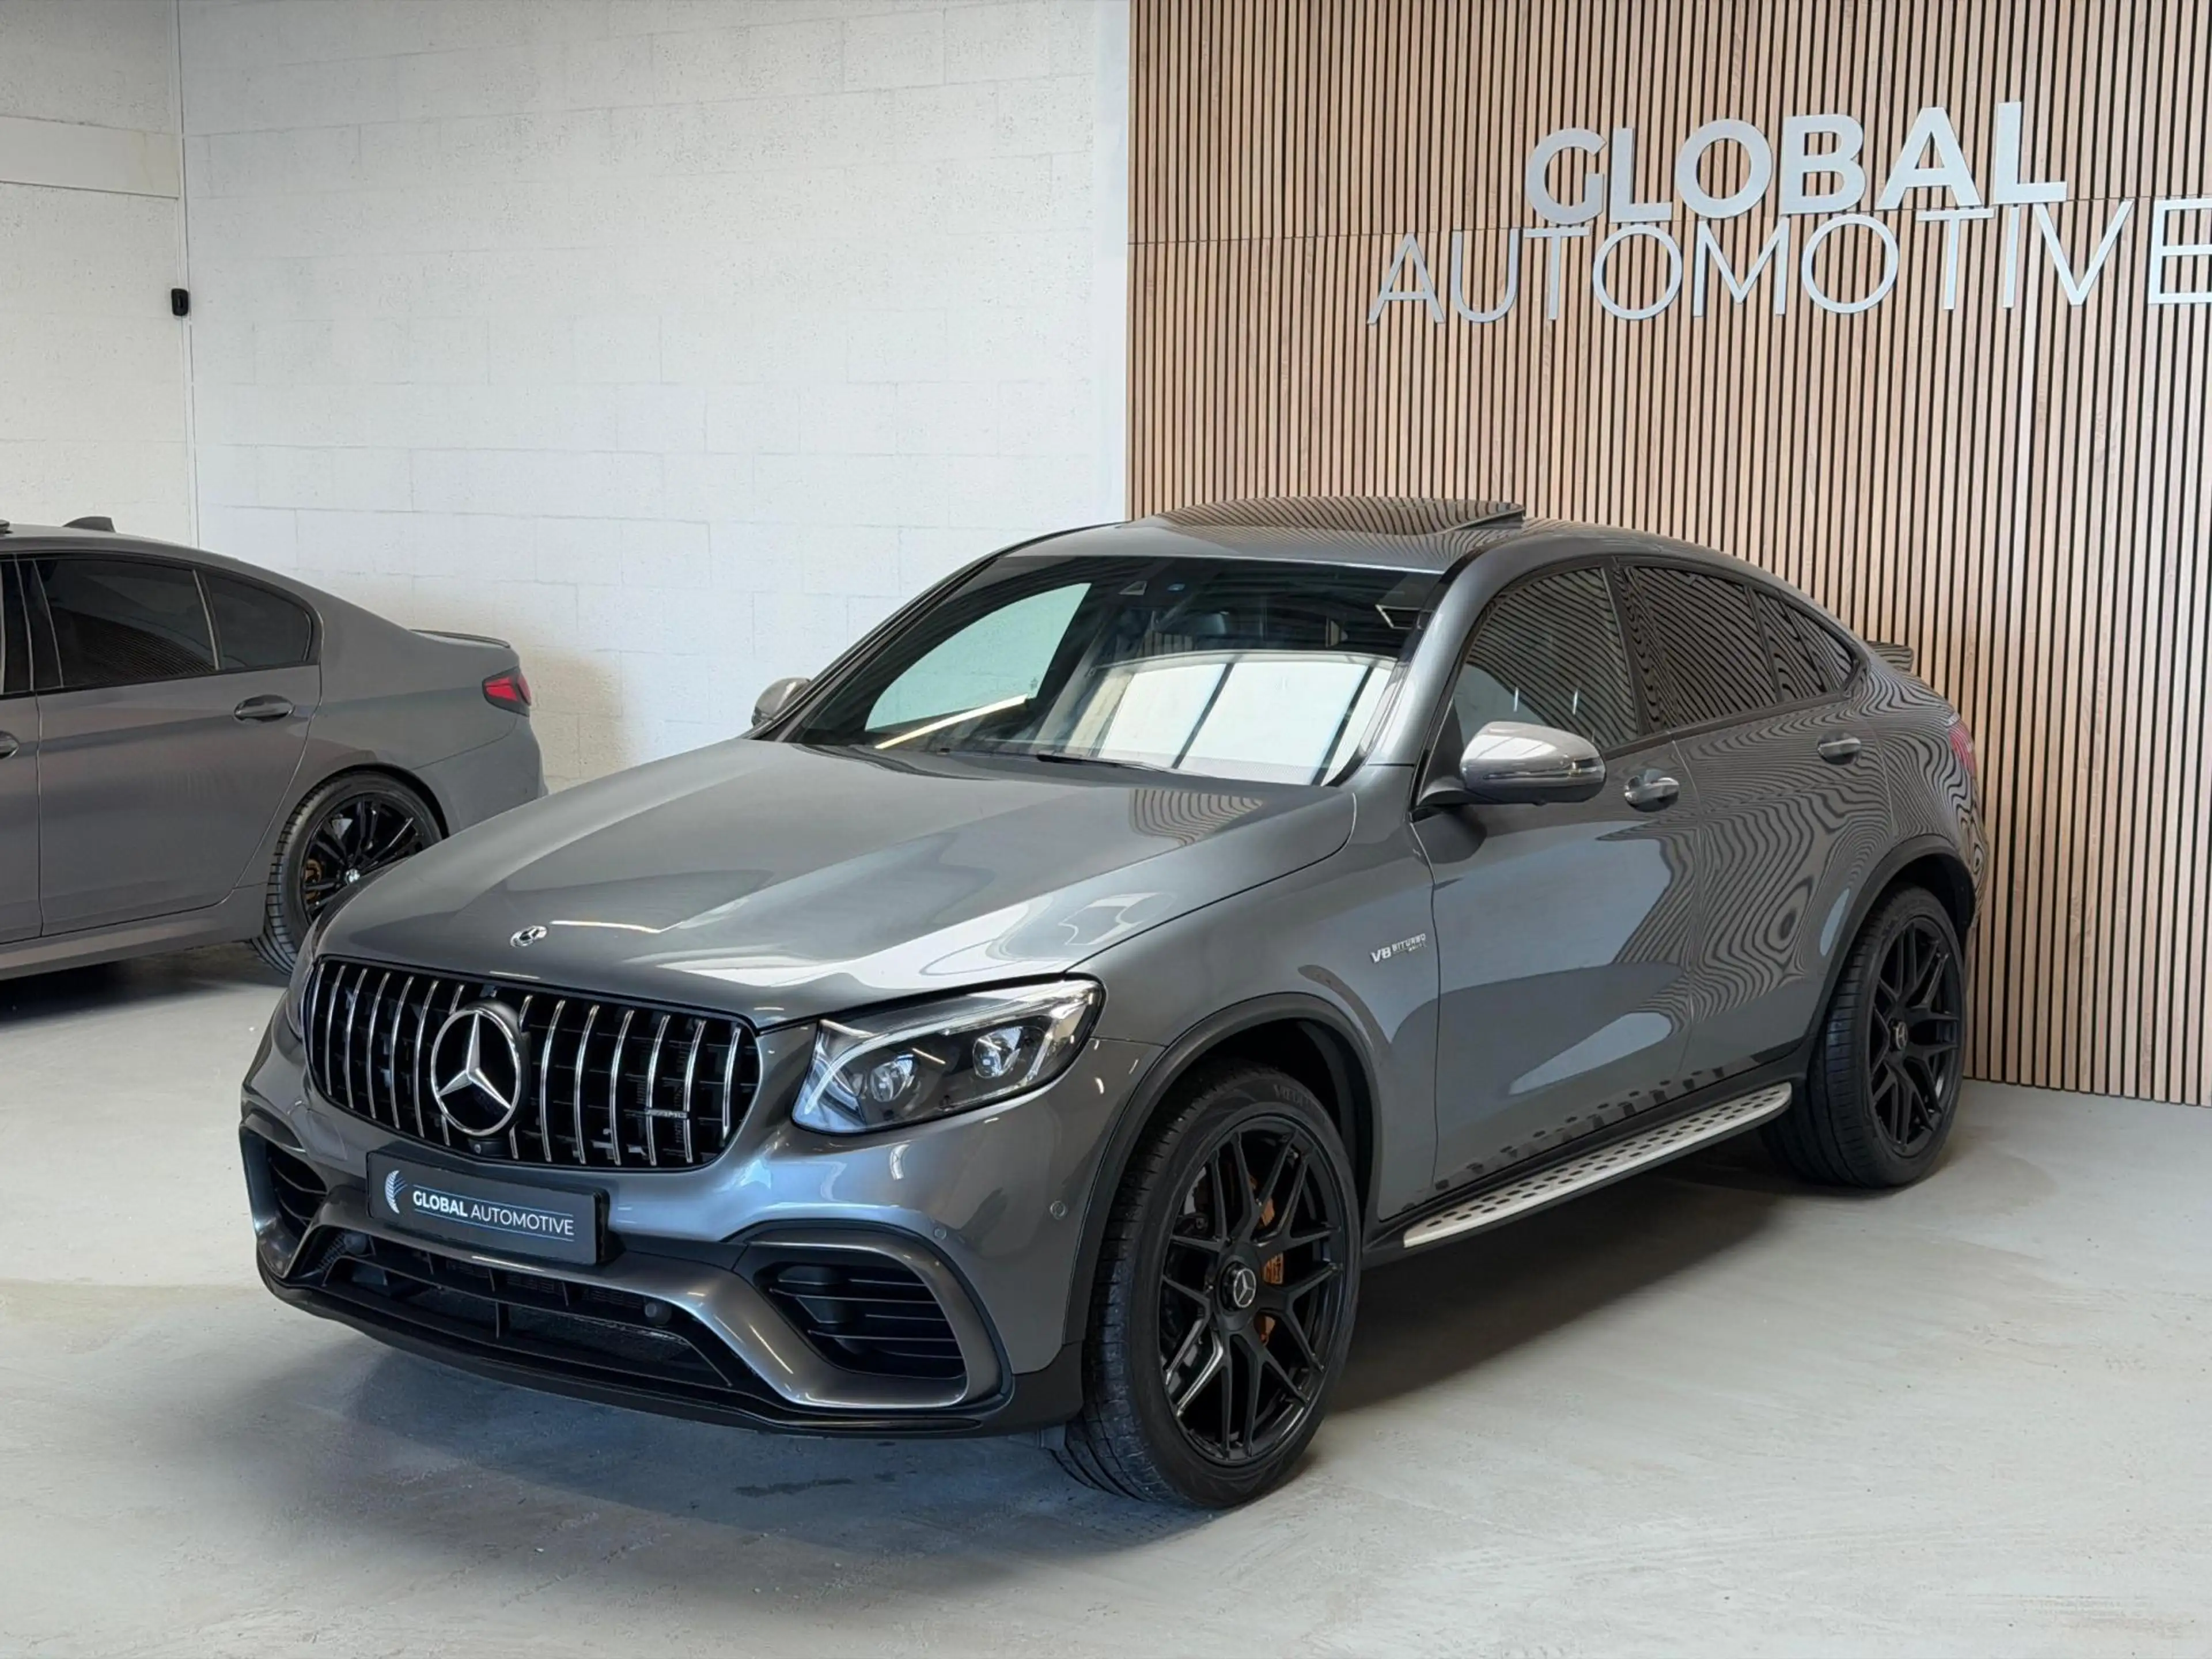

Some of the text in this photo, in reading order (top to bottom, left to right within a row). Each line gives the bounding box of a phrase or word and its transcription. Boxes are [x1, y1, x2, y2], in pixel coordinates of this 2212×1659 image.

[1525, 101, 2069, 225] GLOBAL
[1367, 198, 2212, 325] AUTOMOTIVE
[1370, 946, 1392, 963] V8
[413, 1190, 575, 1236] GLOBAL AUTOMOTIVE
